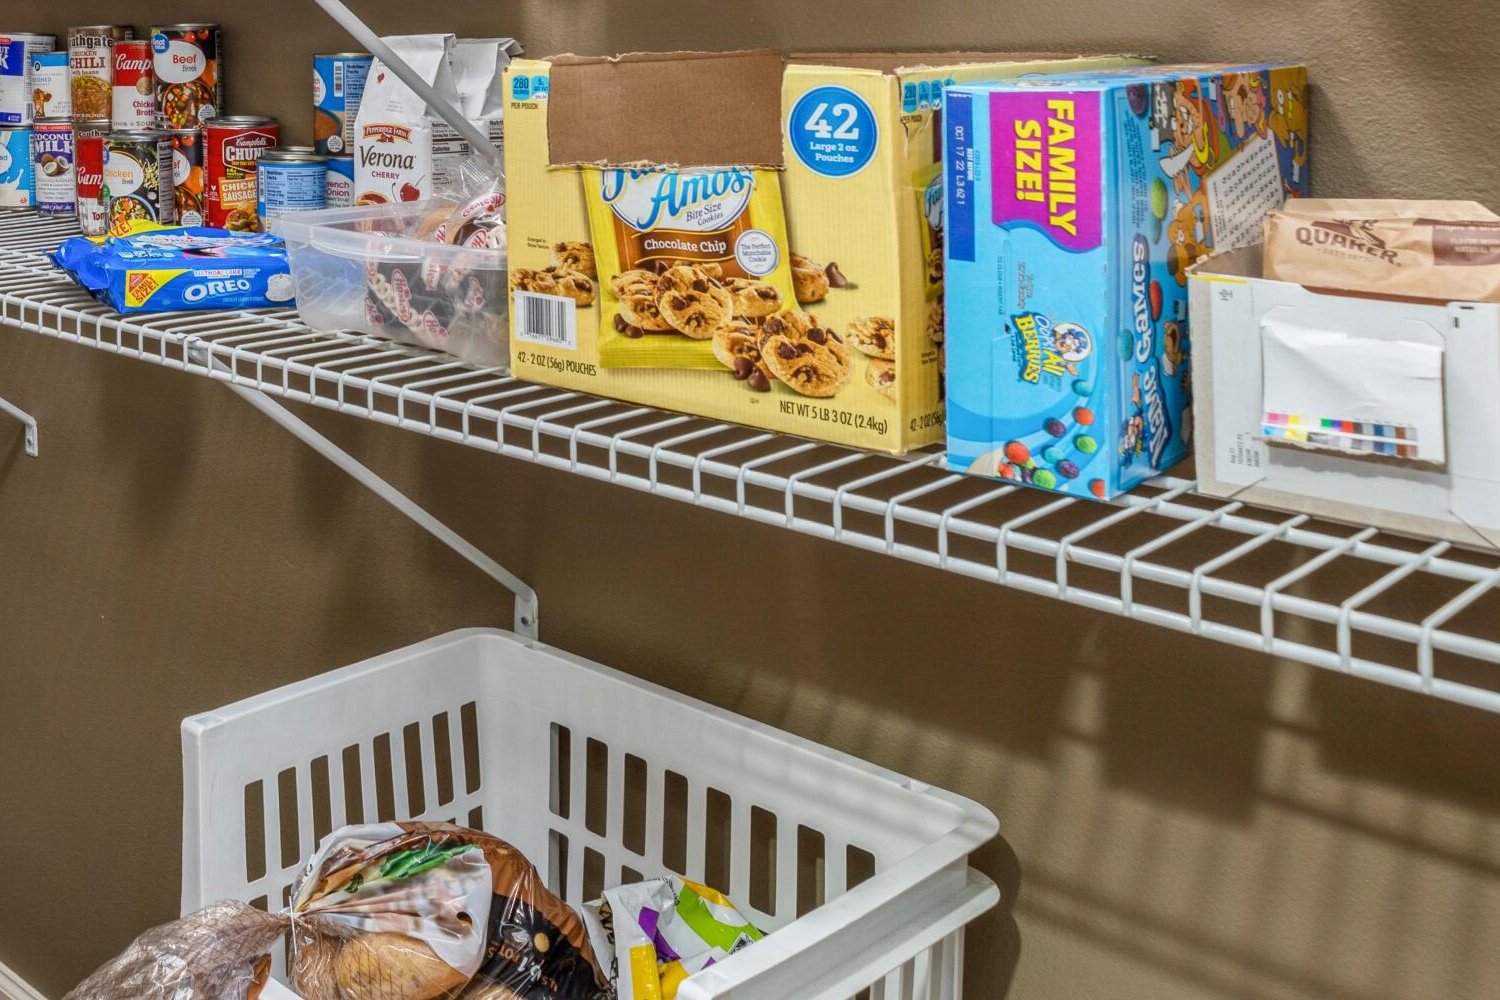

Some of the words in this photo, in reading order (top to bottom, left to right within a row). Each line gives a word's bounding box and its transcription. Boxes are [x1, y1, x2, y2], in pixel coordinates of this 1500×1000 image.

[70, 57, 106, 68] CHILI
[172, 54, 197, 64] Beef
[513, 77, 529, 88] 280
[803, 102, 860, 141] 42
[366, 126, 392, 135] PEPPERIDGE
[954, 126, 964, 141] OCT
[809, 141, 836, 153] Large
[837, 143, 843, 152] 2
[955, 146, 964, 156] 17
[360, 145, 414, 170] Verona
[815, 152, 855, 164] Pouches
[955, 160, 965, 171] 22
[1014, 119, 1045, 205] SIZE!
[371, 171, 400, 180] CHERRY
[1046, 99, 1077, 238] FAMILY
[223, 192, 257, 201] SAUSAGE
[686, 209, 702, 222] Bite
[704, 202, 722, 215] Size
[697, 212, 724, 226] Cookies
[644, 239, 698, 251] Chocolate
[700, 240, 727, 254] Chip
[1296, 228, 1399, 265] QUAKER
[130, 275, 154, 299] FAMILY
[136, 279, 158, 303] SIZE!
[184, 280, 250, 302] OREO
[1131, 241, 1152, 365] Games
[1015, 312, 1044, 386] BERRIES
[531, 354, 536, 366] 2
[537, 354, 548, 368] OZ
[548, 356, 564, 373] (56g)
[566, 360, 597, 378] POUCHES
[779, 399, 795, 414] NET
[796, 402, 810, 417] WT
[812, 405, 818, 418] 5
[819, 406, 830, 420] LB
[832, 408, 838, 421] 3
[839, 409, 853, 425] OZ
[854, 412, 888, 435] (2.4kg)
